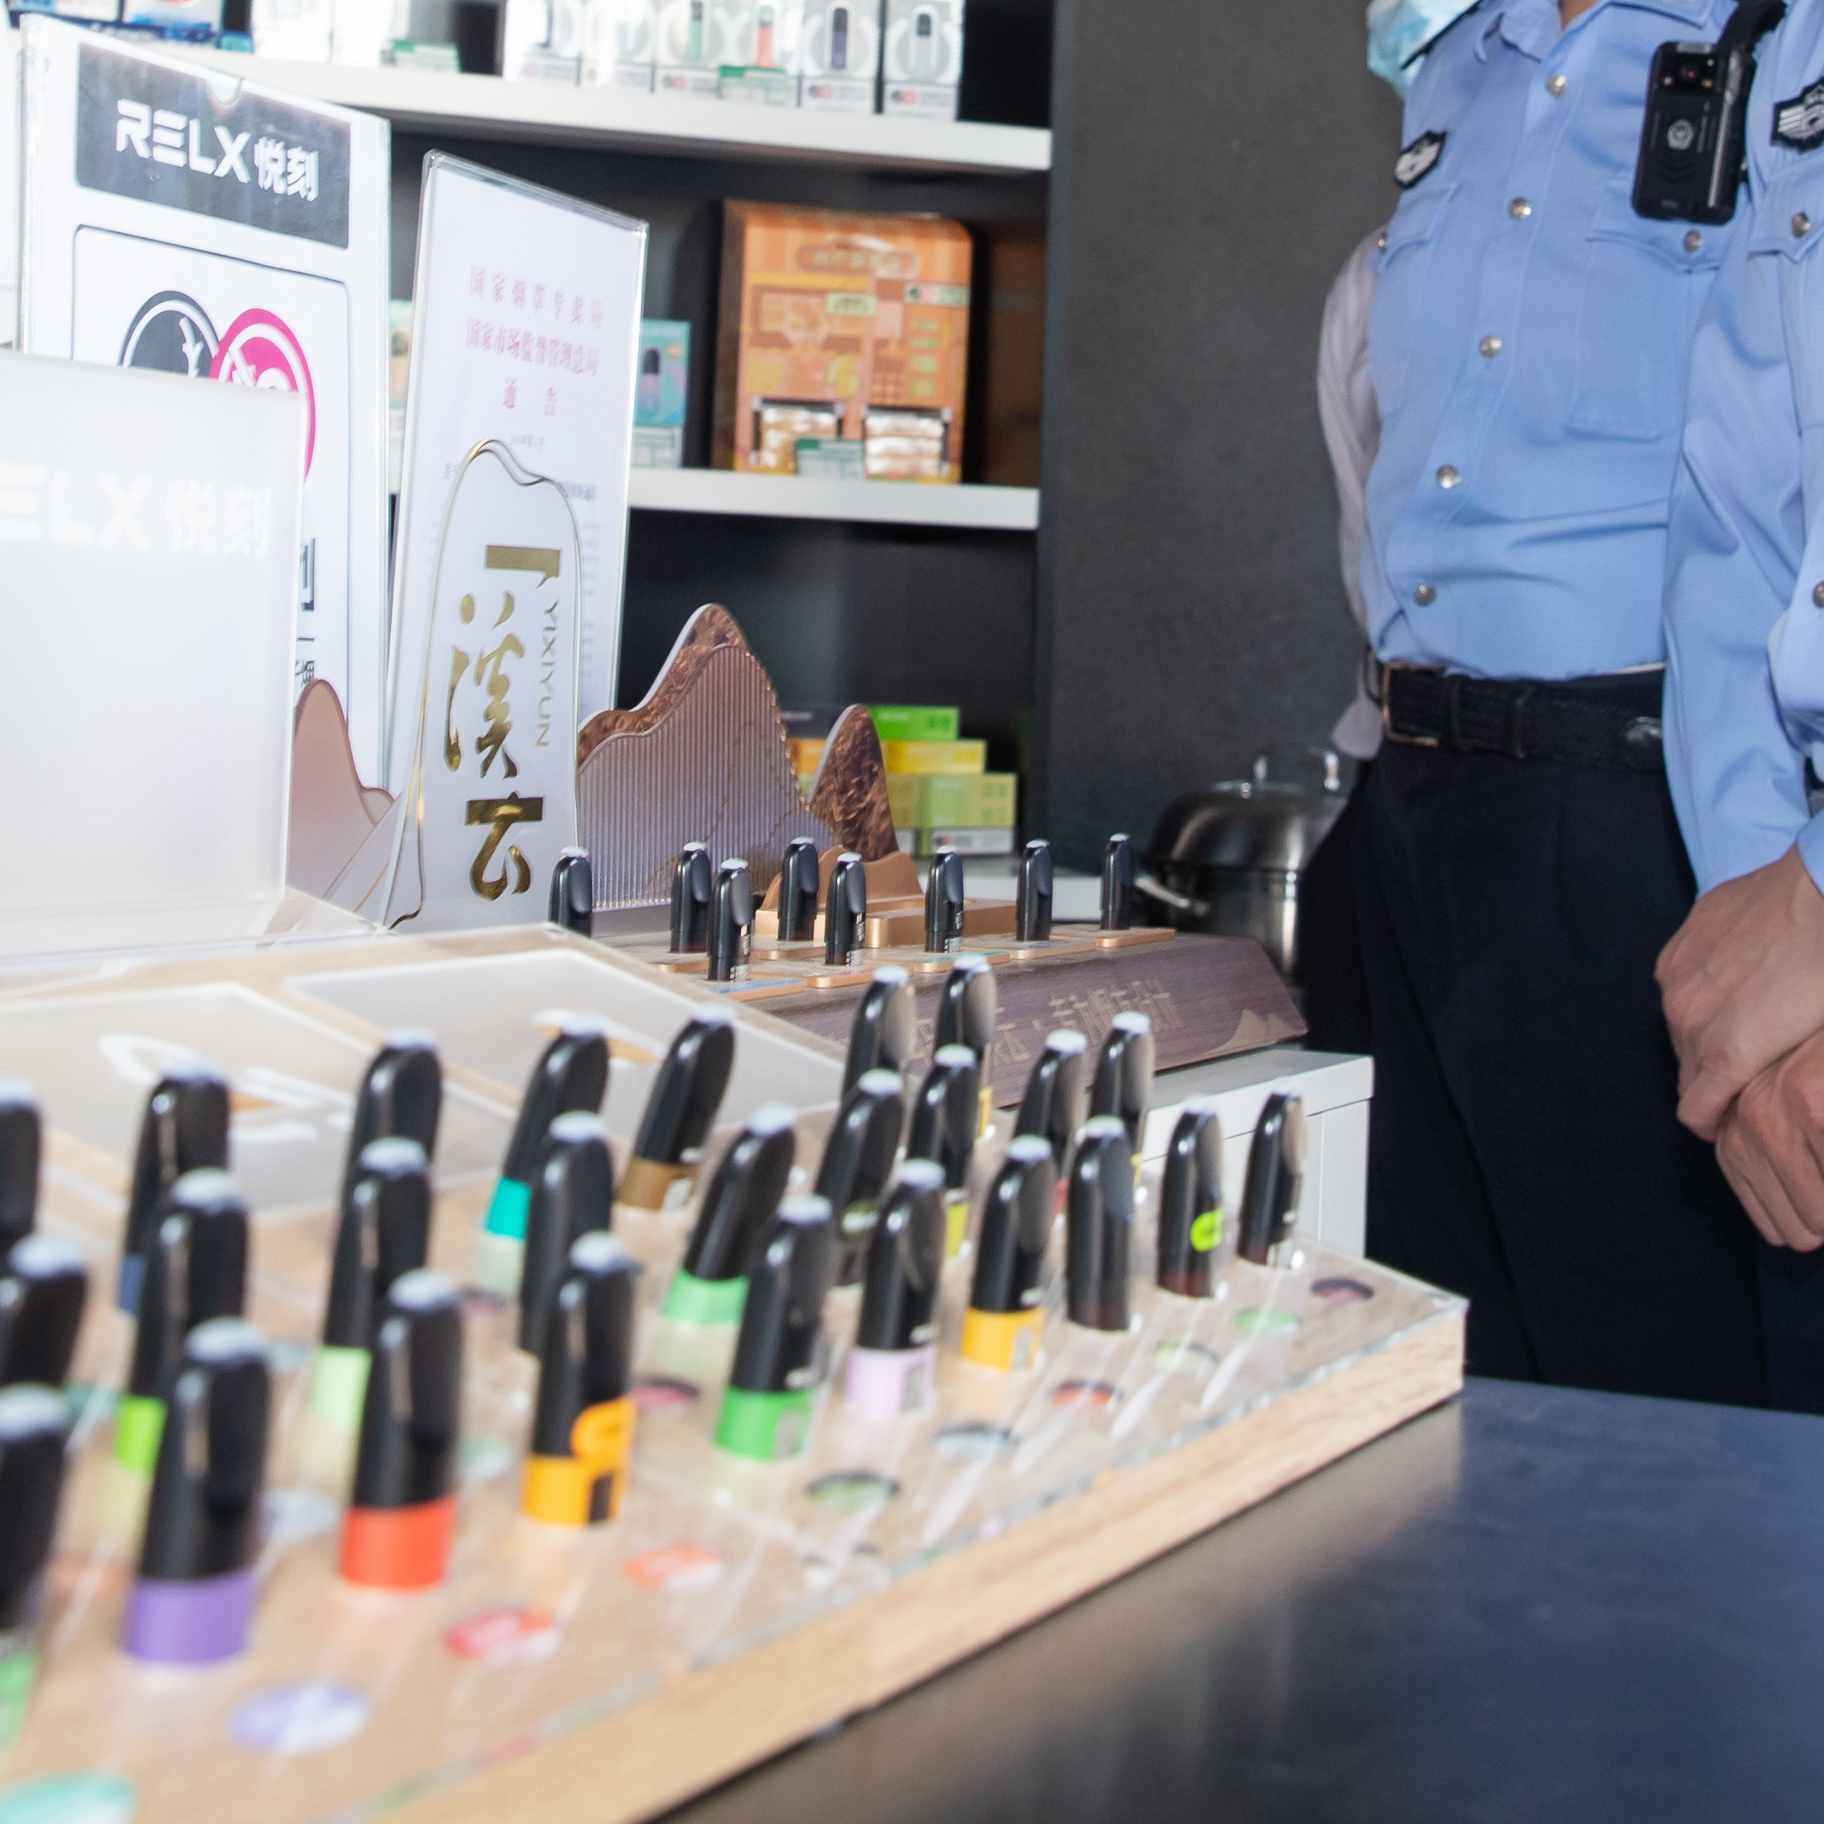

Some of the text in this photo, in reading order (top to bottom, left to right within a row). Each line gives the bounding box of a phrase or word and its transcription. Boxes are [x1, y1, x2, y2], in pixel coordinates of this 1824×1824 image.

[116, 98, 320, 202] RELX 悦刻
[535, 599, 560, 749] YIXIYUN
